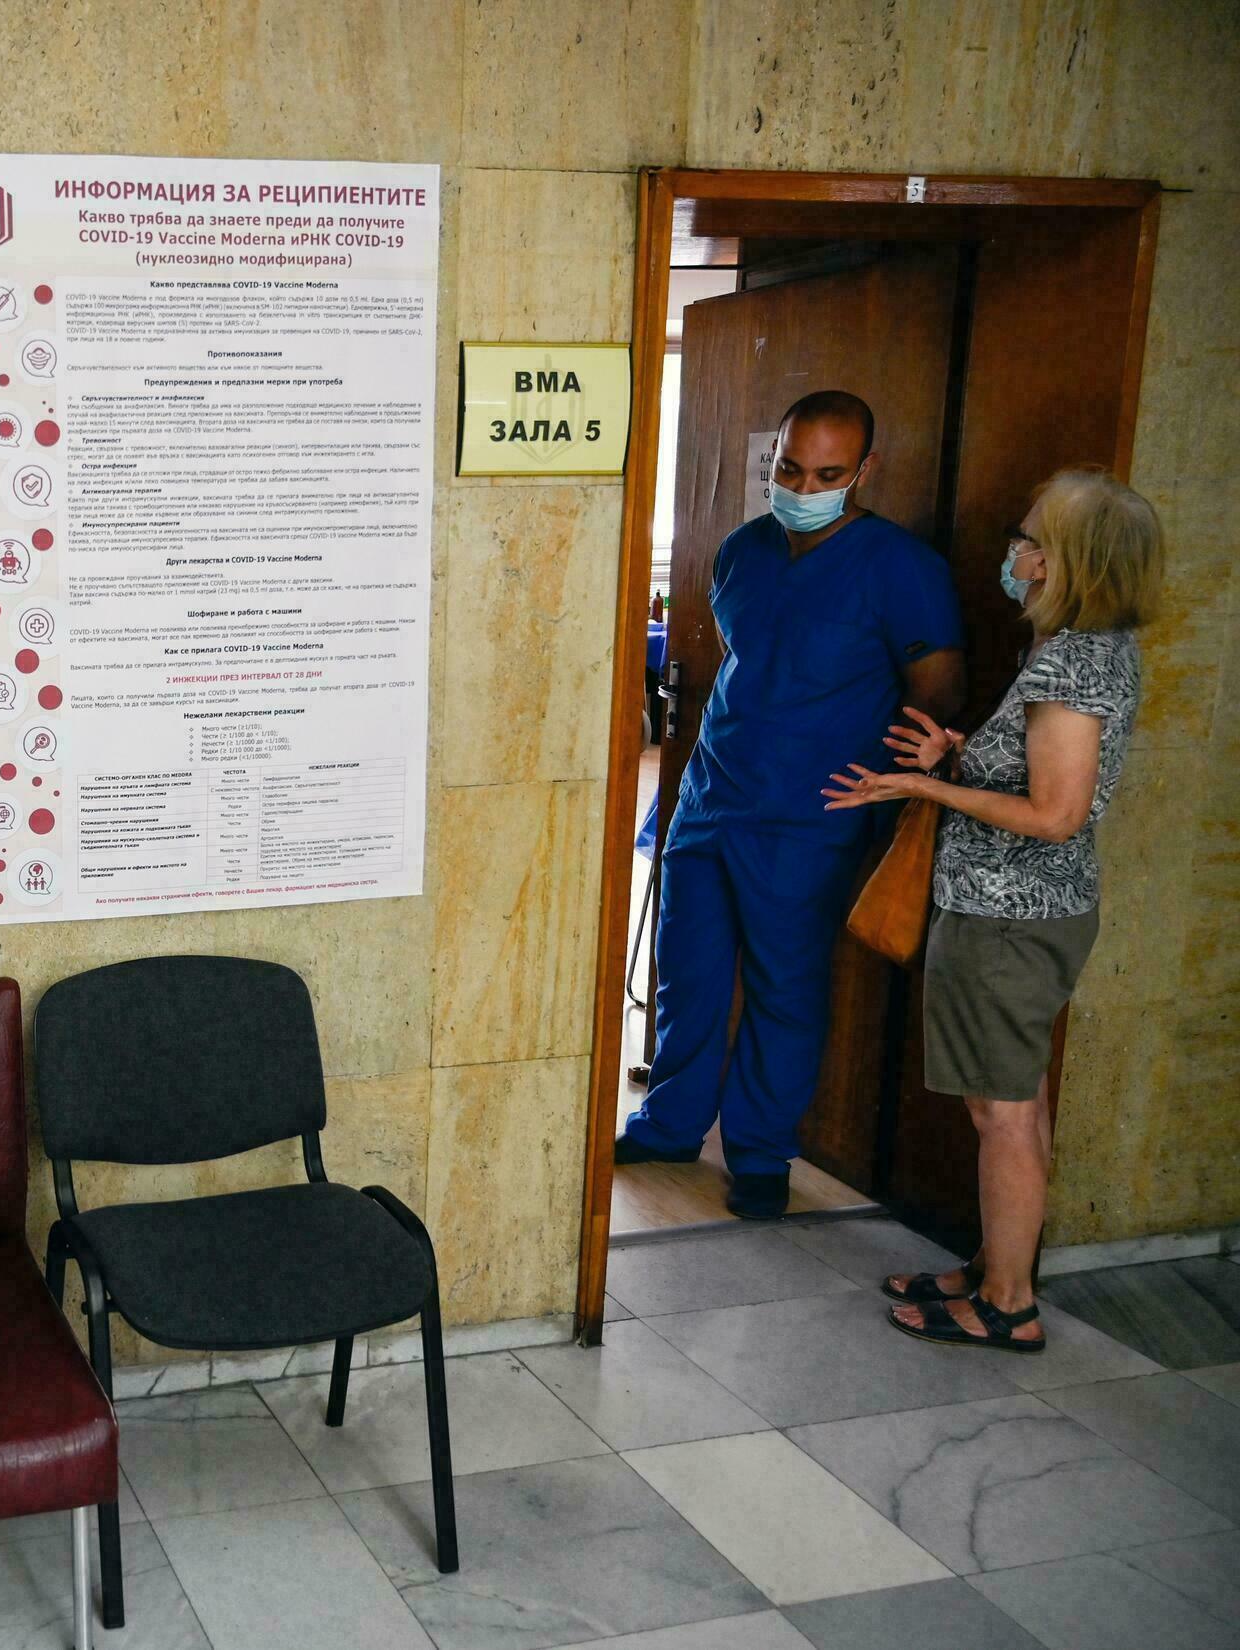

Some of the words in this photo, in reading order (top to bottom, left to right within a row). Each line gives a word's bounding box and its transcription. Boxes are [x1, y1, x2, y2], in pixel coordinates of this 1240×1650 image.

[54, 180, 214, 205] ИНФОРМАЦИЯ
[223, 184, 250, 202] ЗА
[258, 184, 425, 208] РЕЦИПИЕНТИТЕ
[911, 184, 919, 196] 5
[78, 209, 124, 223] Какво
[130, 211, 181, 227] трябва
[186, 215, 204, 227] да
[209, 215, 260, 226] знаете
[266, 216, 311, 229] преди
[316, 216, 333, 228] да
[339, 217, 404, 231] получите
[79, 229, 152, 244] COVID-19
[158, 231, 215, 244] Vaccine
[220, 232, 284, 245] Moderna
[290, 233, 330, 245] иРНК
[335, 233, 403, 247] COVID-19
[136, 251, 234, 267] (нуклеозидно
[239, 252, 352, 267] модифицирана)
[207, 350, 282, 358] Противопоказания
[144, 378, 212, 386] Предупреждения
[309, 378, 343, 386] употреба
[515, 372, 581, 392] ВМА
[489, 420, 572, 442] ЗАЛА
[584, 420, 601, 442] 5
[187, 610, 228, 618] Шофиране
[237, 608, 263, 616] работа
[224, 644, 260, 652] COVID-19
[172, 675, 218, 683] ИНЖЕКЦИИ
[240, 672, 281, 680] ИНТЕРВАЛ
[305, 670, 322, 678] ДНИ
[183, 711, 222, 719] Нежелани
